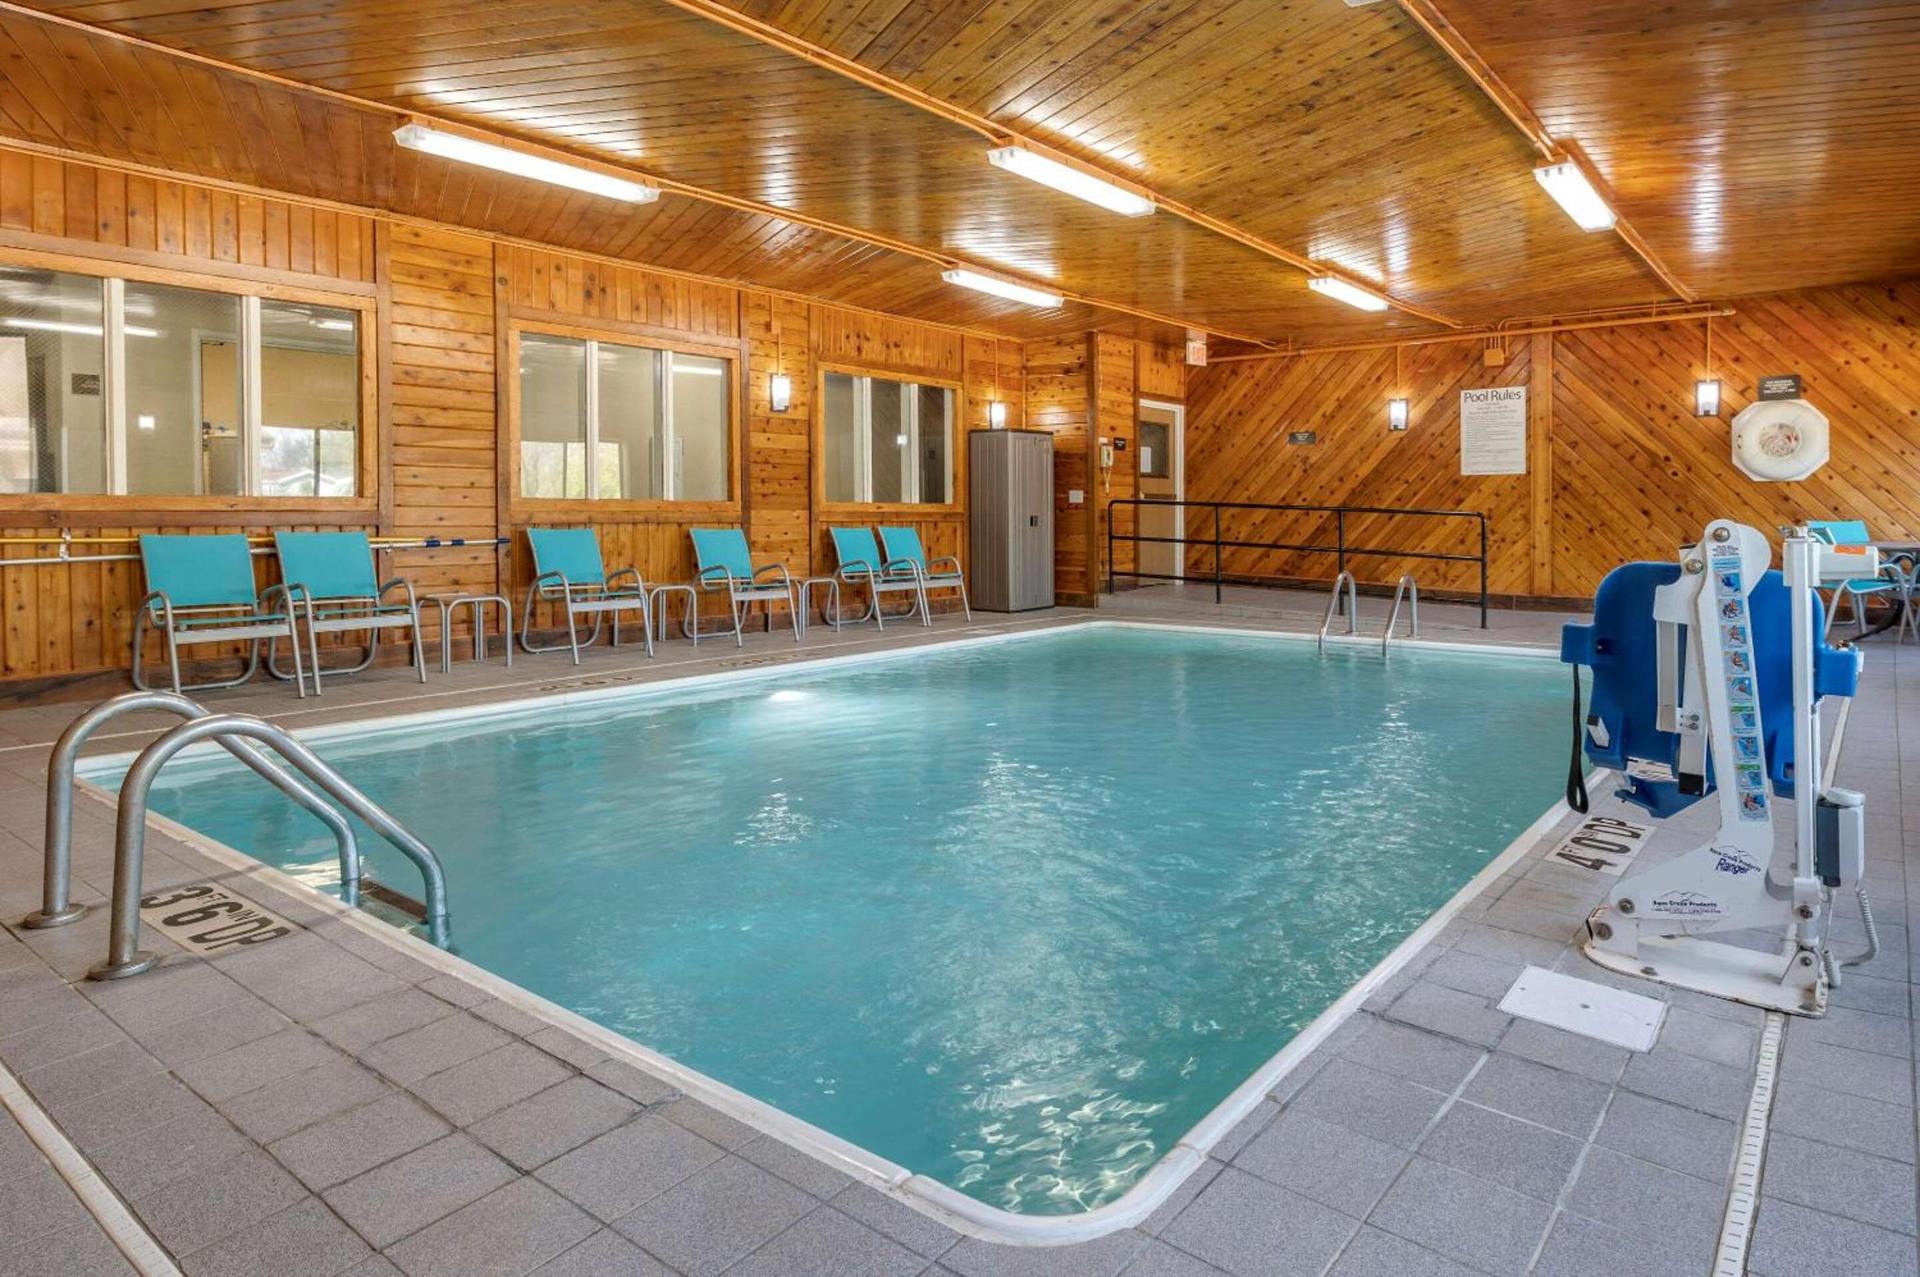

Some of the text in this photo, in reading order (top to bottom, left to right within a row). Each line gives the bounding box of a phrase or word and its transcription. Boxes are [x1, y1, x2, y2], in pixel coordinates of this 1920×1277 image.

[1464, 389, 1522, 402] Pool Rules
[1556, 852, 1618, 871] 4
[1715, 857, 1750, 875] Ranger
[139, 885, 214, 909] 3
[162, 901, 244, 927] 6
[187, 916, 291, 951] DP
